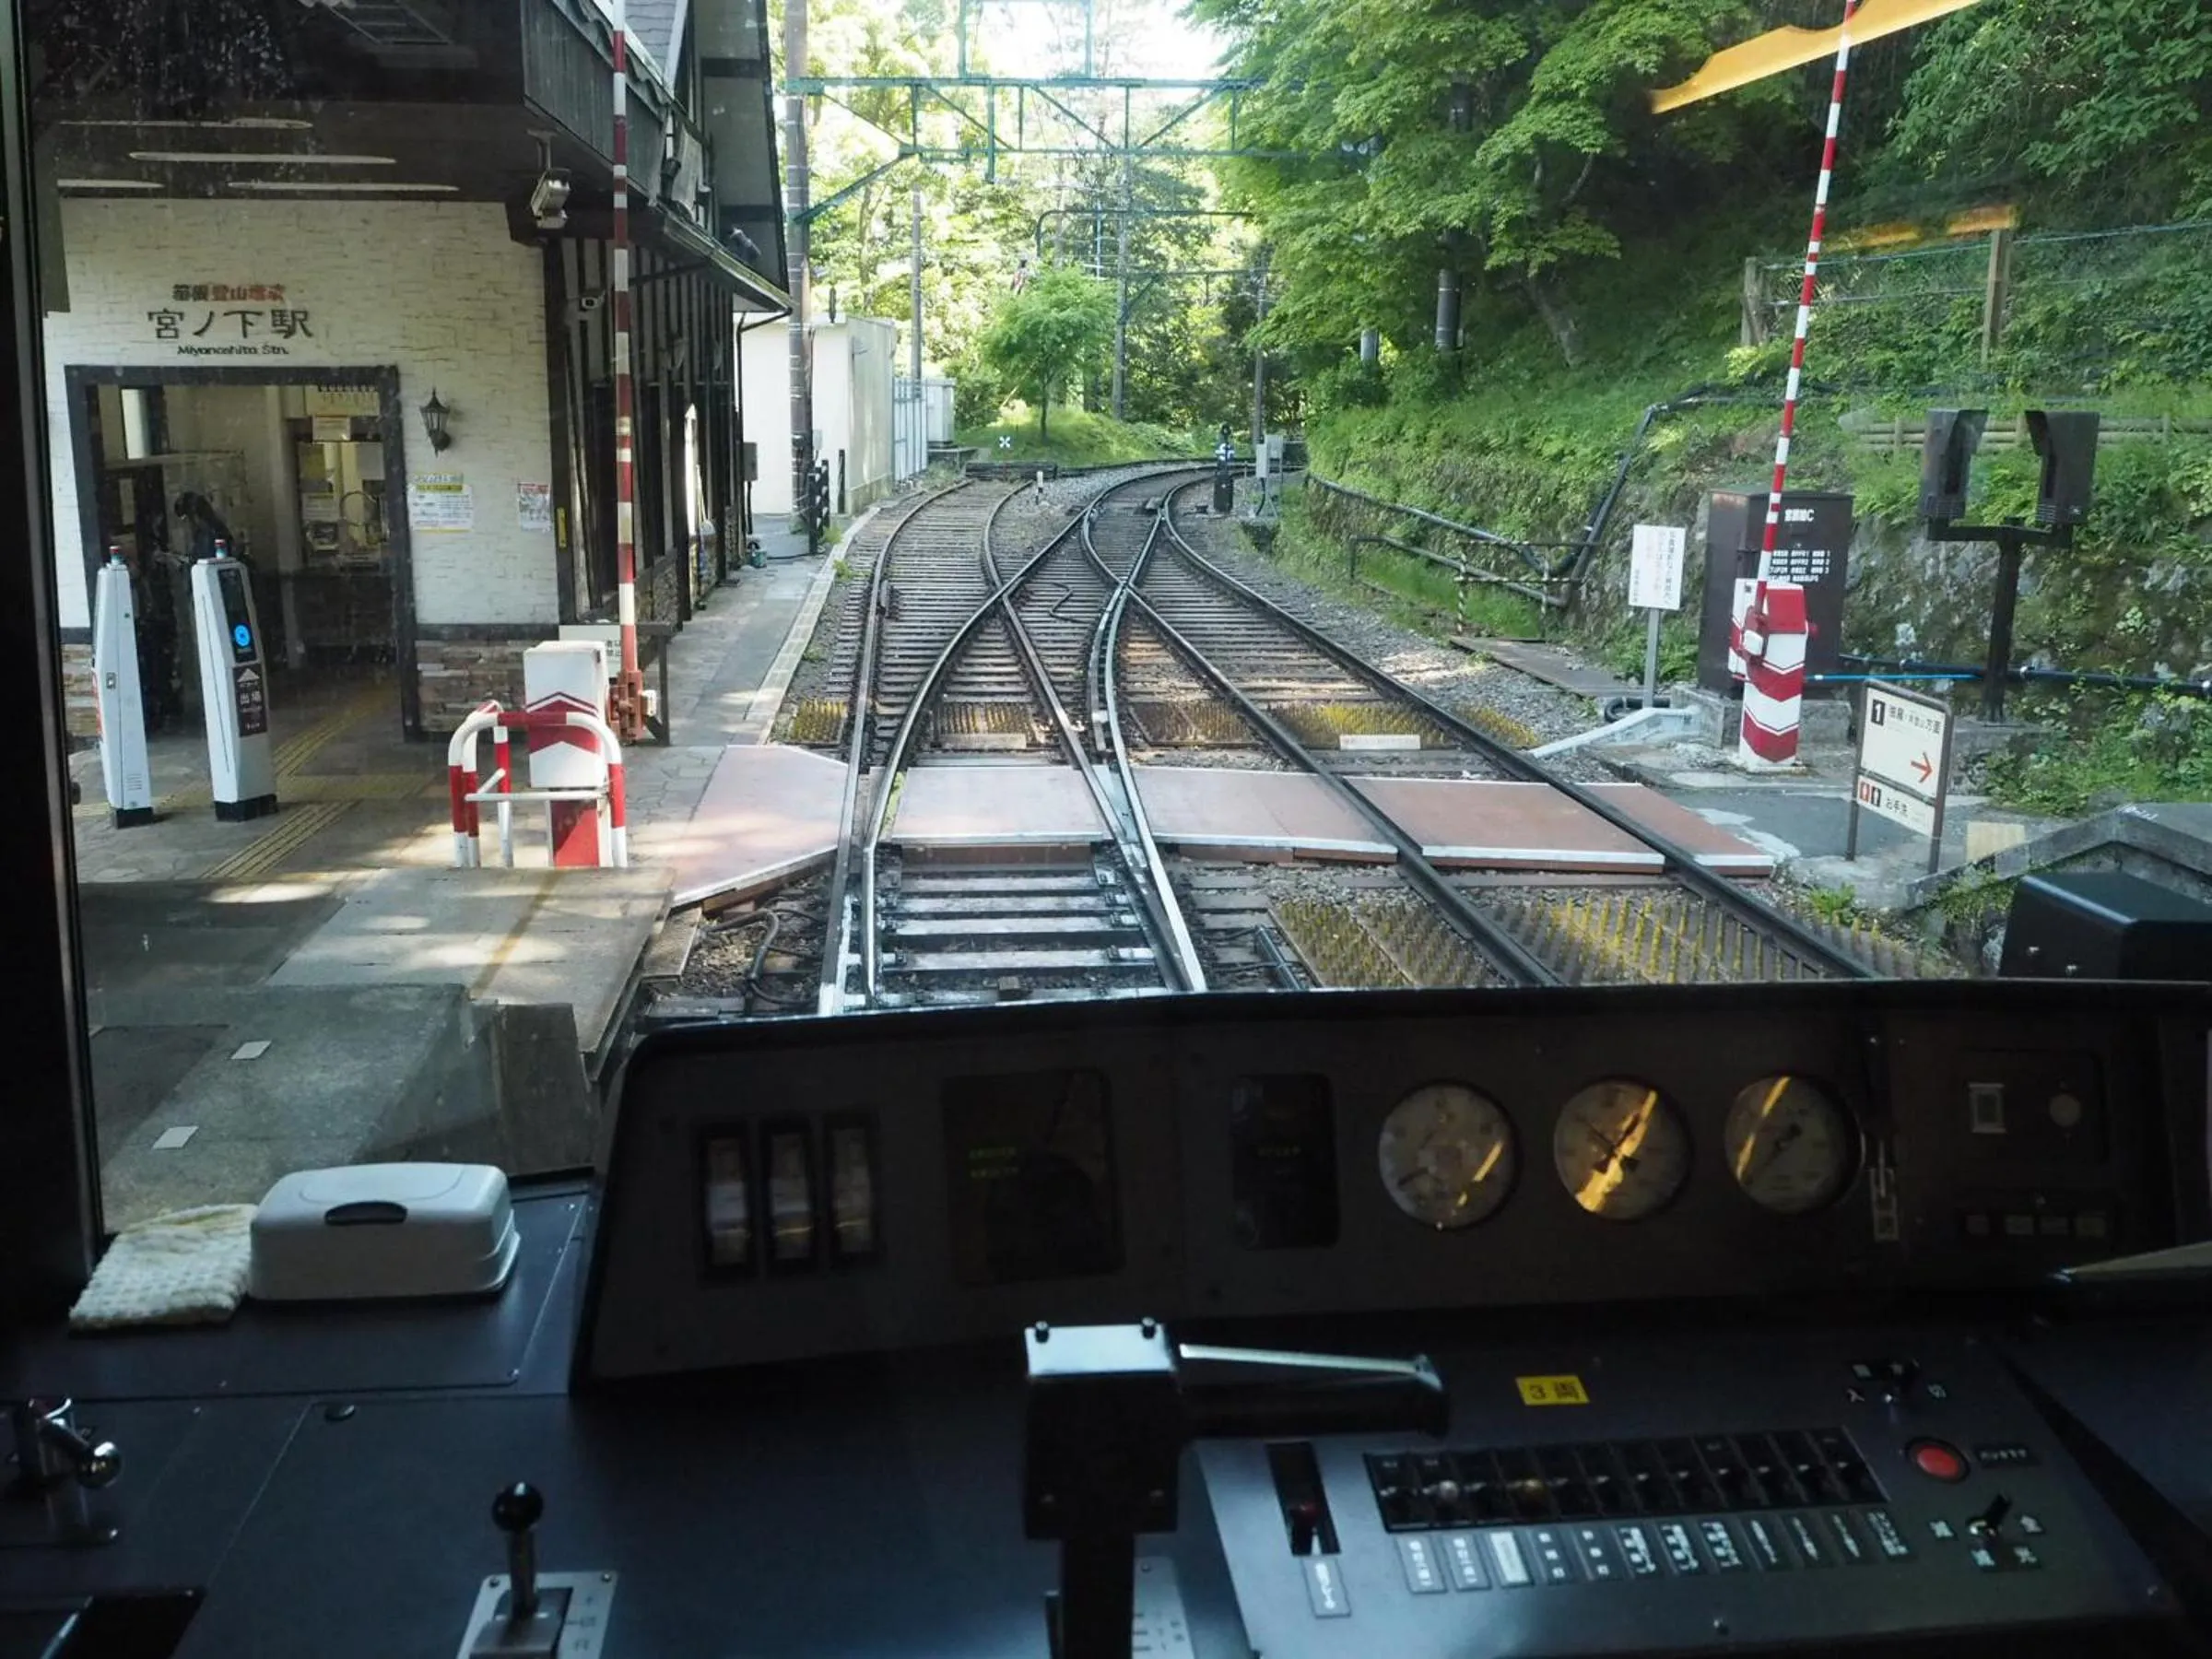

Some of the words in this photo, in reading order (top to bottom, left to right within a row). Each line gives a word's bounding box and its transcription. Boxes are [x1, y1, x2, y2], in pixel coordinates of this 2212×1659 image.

[147, 308, 314, 339] 宮ノ下駅
[177, 346, 258, 357] Miyanoshita
